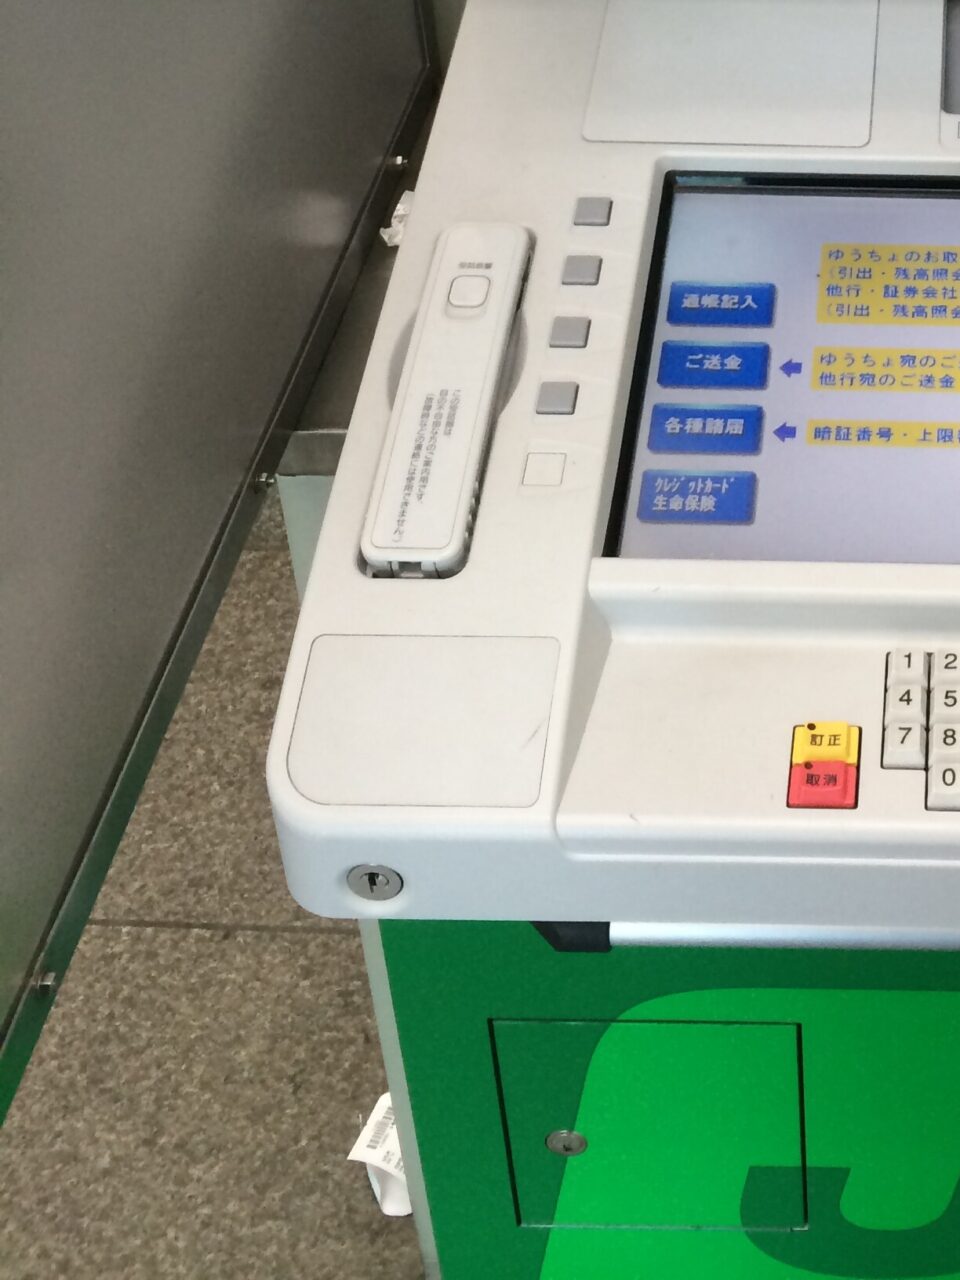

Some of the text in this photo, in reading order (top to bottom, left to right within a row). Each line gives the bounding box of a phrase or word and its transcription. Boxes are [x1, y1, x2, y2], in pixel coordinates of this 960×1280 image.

[685, 354, 743, 371] ご送金
[818, 372, 956, 389] 他行宛のご送金
[651, 495, 717, 512] 生命保険
[904, 654, 912, 669] 1
[944, 654, 957, 669] 2
[899, 690, 912, 705] 4
[944, 690, 957, 707] 5
[810, 734, 841, 747] 訂正
[899, 728, 912, 744] 7
[943, 729, 956, 746] 8
[806, 774, 837, 786] 取消
[942, 769, 956, 786] 0
